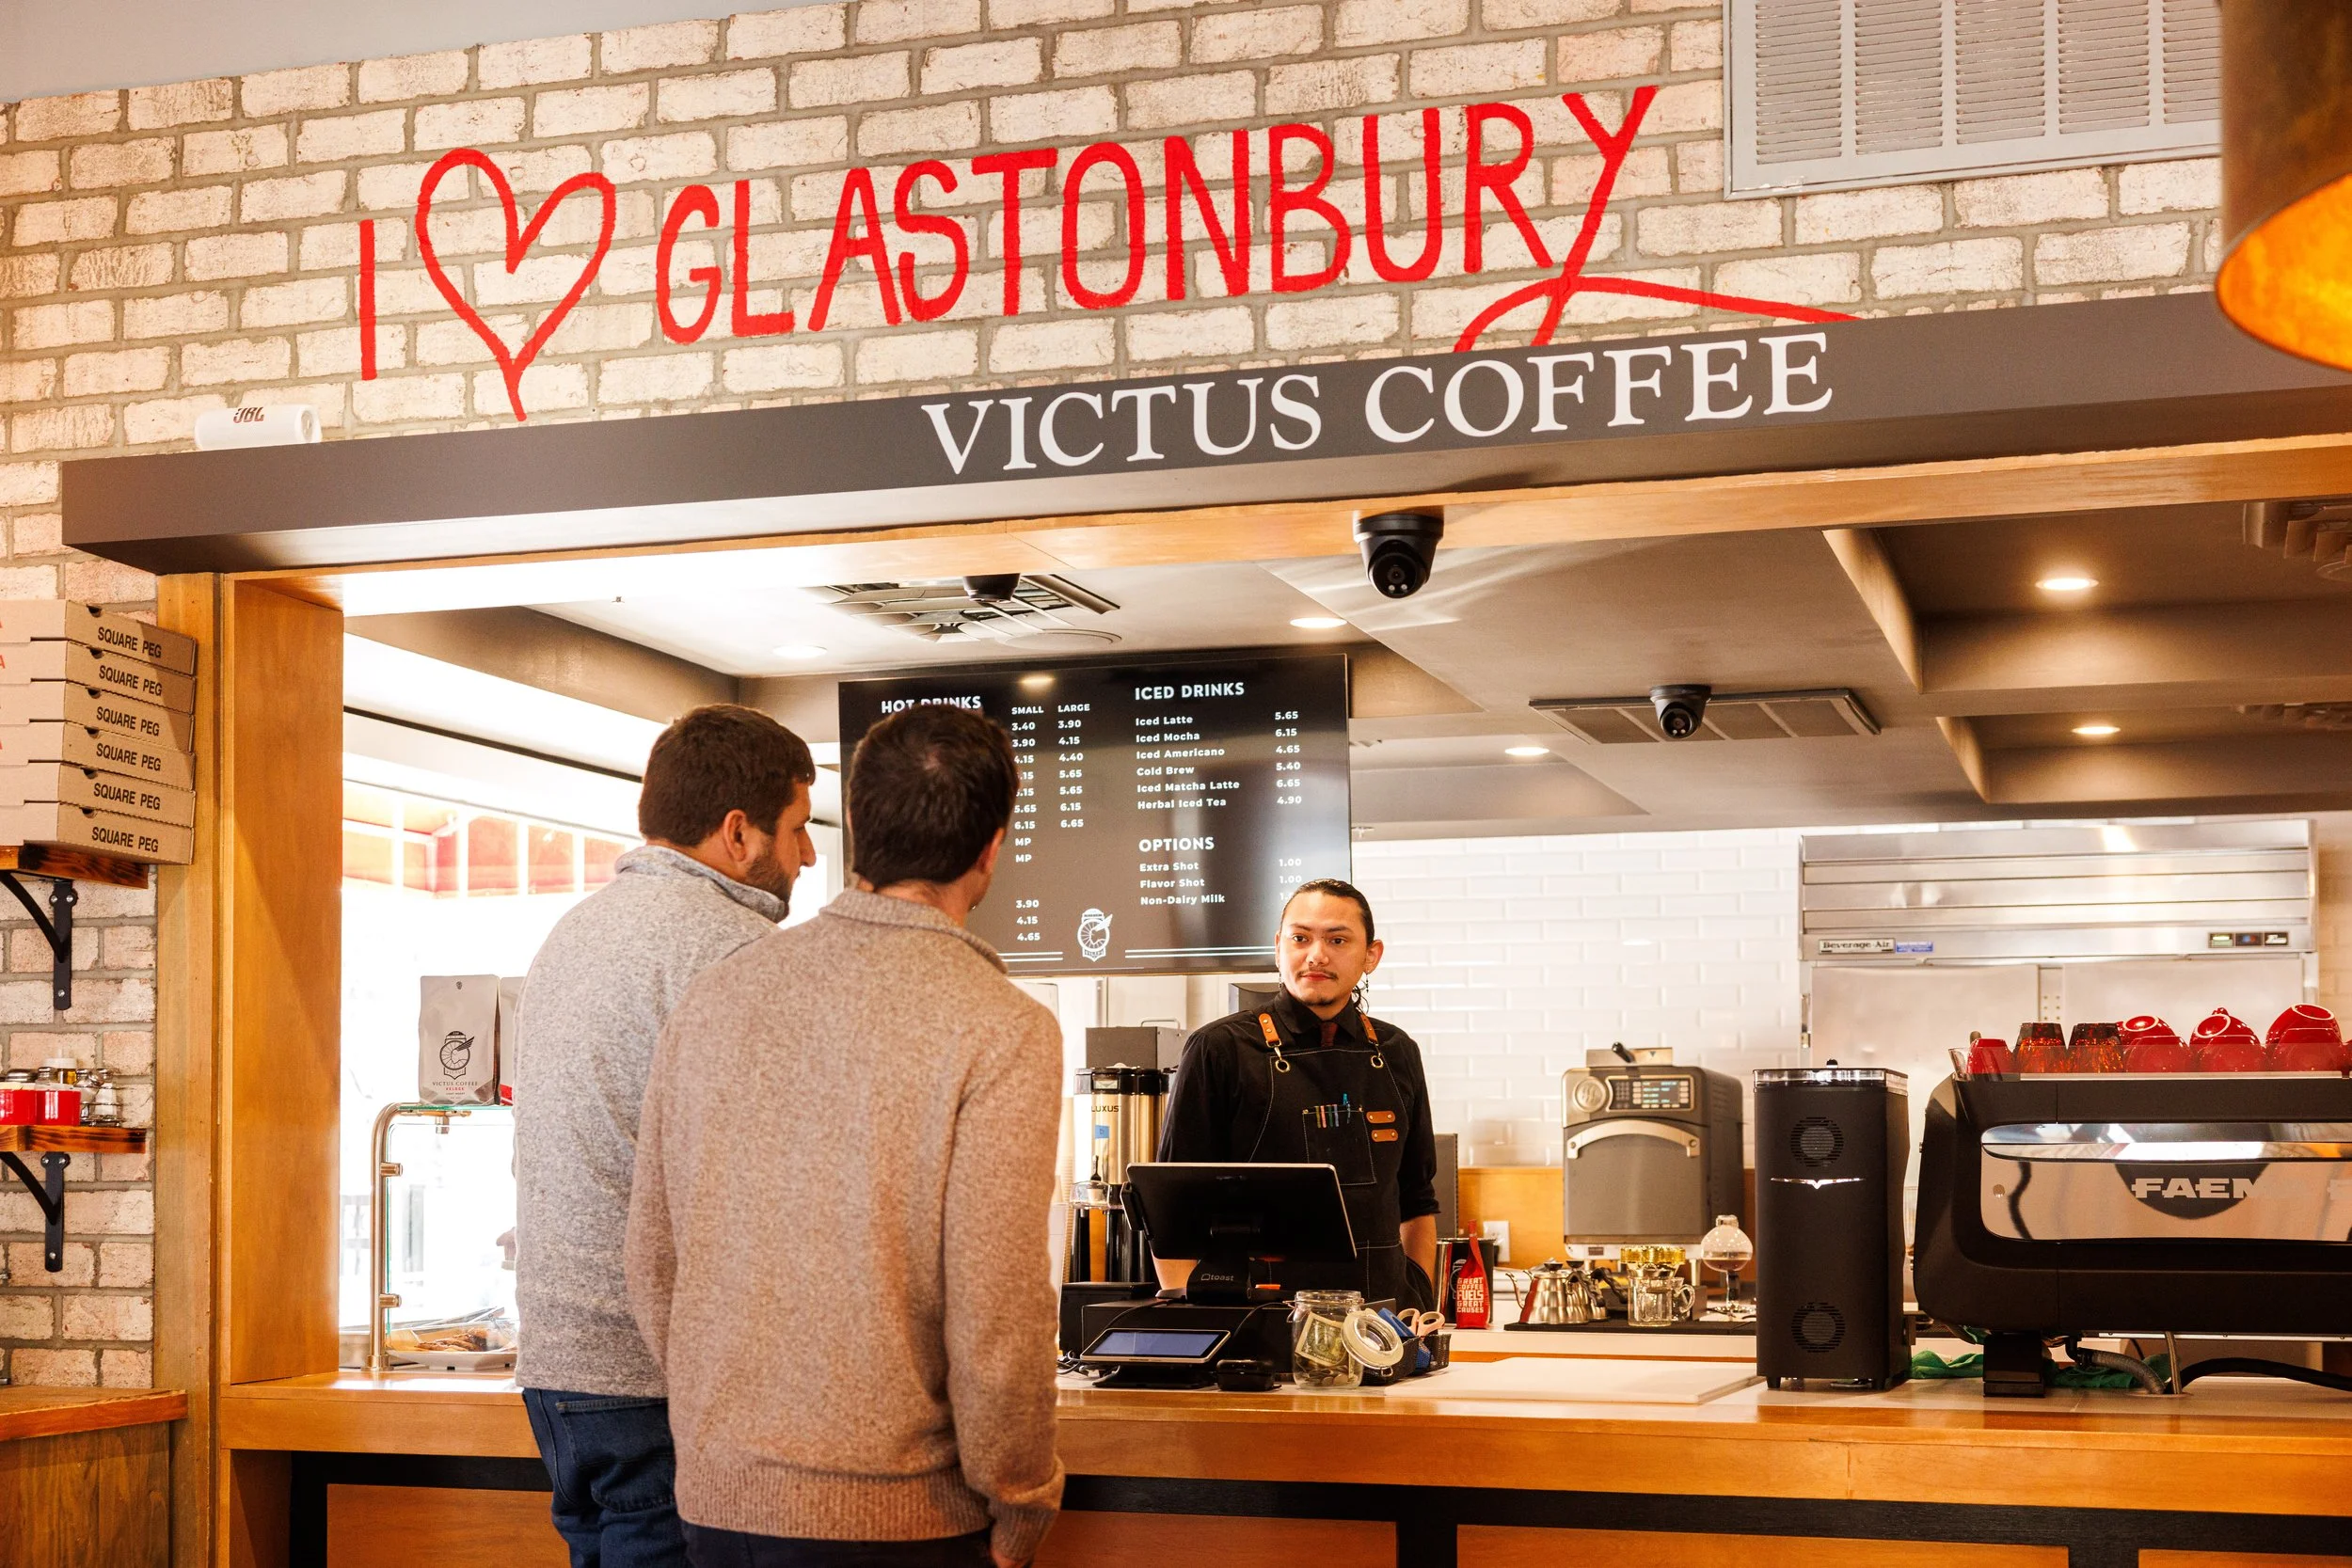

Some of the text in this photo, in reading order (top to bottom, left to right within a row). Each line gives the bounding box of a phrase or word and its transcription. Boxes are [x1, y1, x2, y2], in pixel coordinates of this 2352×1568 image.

[359, 86, 1857, 380] I GLASTONBURY
[922, 331, 1833, 474] VICTUS COFFEE
[233, 406, 264, 423] JBL
[98, 626, 162, 657] SQUARE PEG
[99, 665, 162, 696] SQUARE PEG
[1136, 682, 1245, 701] ICED DRINKS
[882, 700, 914, 713] HOT
[1011, 704, 1090, 715] SMALL LARGE
[97, 706, 159, 736] SQUARE PEG
[1136, 715, 1193, 726] Iced Latte
[1275, 711, 1298, 721] 5.65
[1011, 720, 1081, 732] 3.40 3.90
[1136, 732, 1200, 742] Iced Mocha
[1276, 728, 1296, 737] 6.15
[1011, 736, 1080, 747] 3.90 4.15
[1136, 747, 1225, 759] Iced Americano
[1276, 744, 1300, 753] 4.65
[96, 743, 161, 771] SQUARE PEG
[1013, 752, 1084, 764] 4.15 4.40
[1136, 766, 1194, 776] Cold Brew
[1276, 762, 1300, 771] 5.40
[1019, 769, 1082, 780] .15 5.65
[1137, 780, 1240, 793] Iced Matcha Latte
[1277, 779, 1300, 787] 6.65
[1060, 786, 1082, 795] 5.65
[94, 784, 160, 811] SQUARE PEG
[1277, 795, 1301, 804] 4.90
[1014, 802, 1081, 813] 5.65 6.15
[1137, 798, 1227, 810] Herbal Iced Tea
[1014, 818, 1084, 830] 6.15 6.65
[92, 827, 158, 852] SQUARE PEG
[1015, 837, 1031, 847] MP
[1138, 837, 1215, 852] OPTIONS
[1015, 854, 1032, 863] MP
[1279, 858, 1301, 867] 1.00
[1139, 862, 1199, 872] Extra Shot
[1140, 878, 1205, 889] Flavor Shot
[1279, 875, 1302, 883] 1.00
[1016, 899, 1039, 909] 3.90
[1140, 894, 1225, 907] Non-Dairy Milk
[1017, 916, 1038, 925] 4.15
[1017, 932, 1040, 942] 4.65
[1457, 1291, 1484, 1300] FUELS
